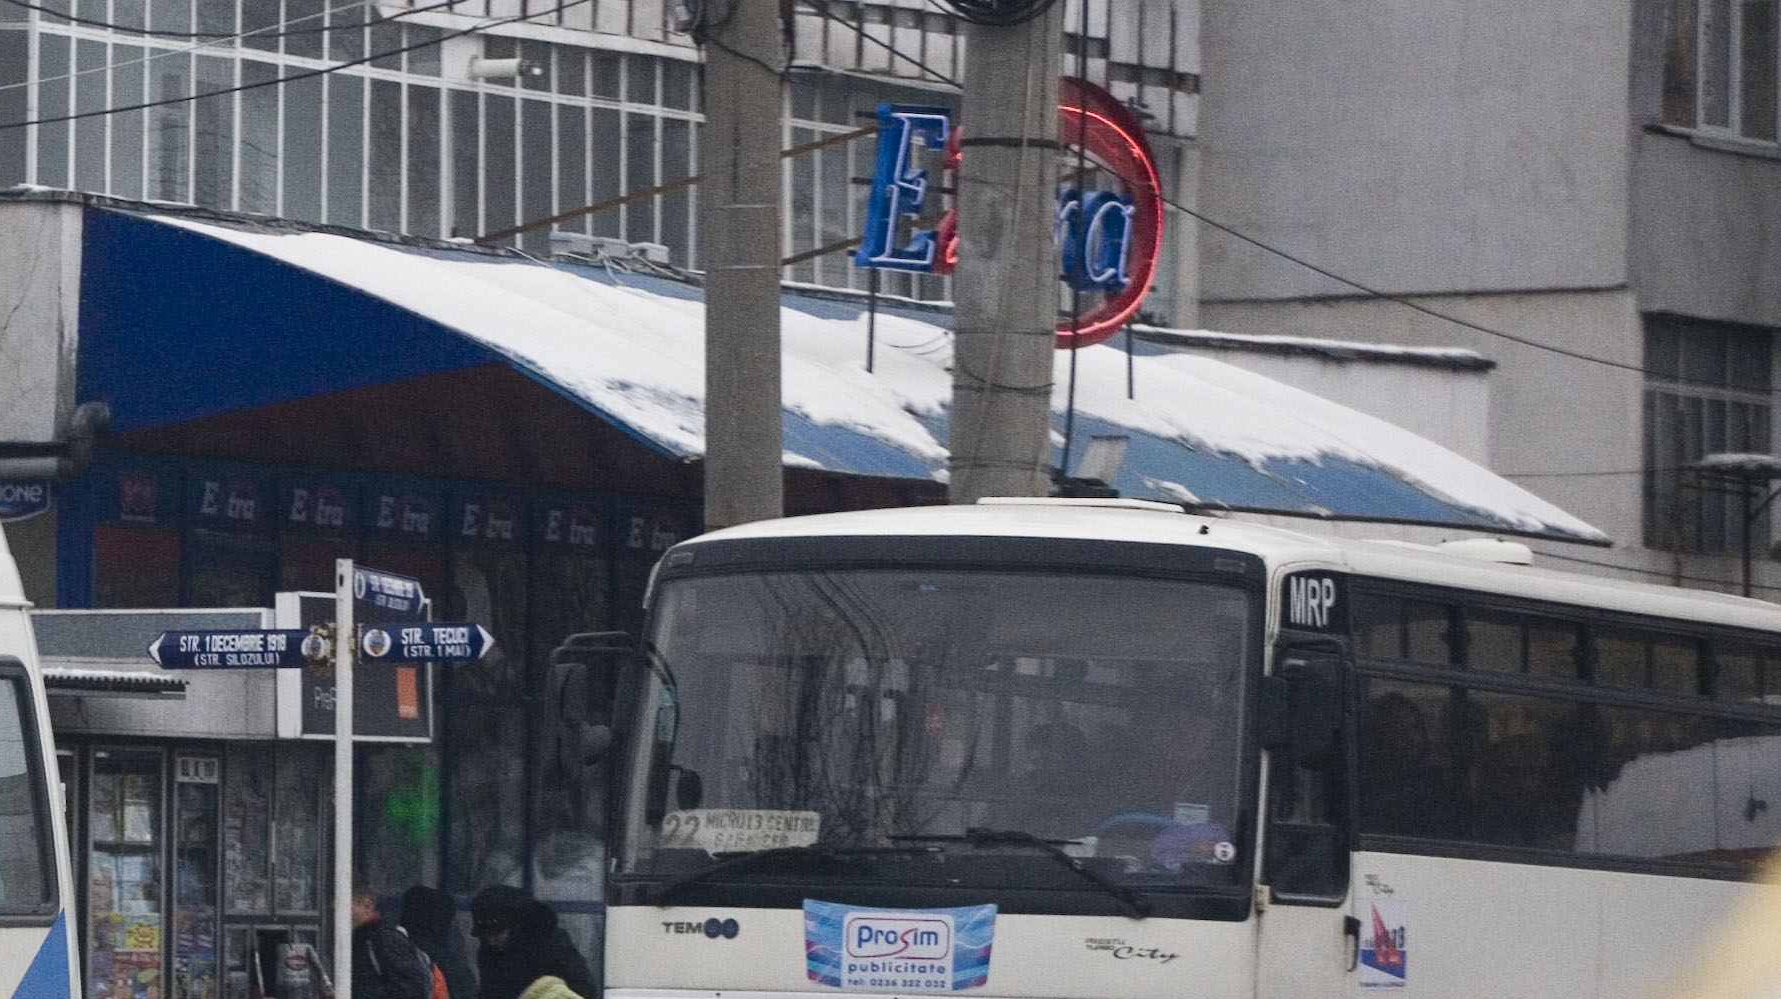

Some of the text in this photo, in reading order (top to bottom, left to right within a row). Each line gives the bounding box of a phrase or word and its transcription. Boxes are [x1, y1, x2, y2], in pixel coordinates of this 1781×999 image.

[1290, 575, 1335, 628] MRP
[179, 635, 201, 653] STR.
[401, 627, 469, 645] STR. TECUCI
[664, 813, 700, 844] 22
[848, 961, 946, 975] publicitate
